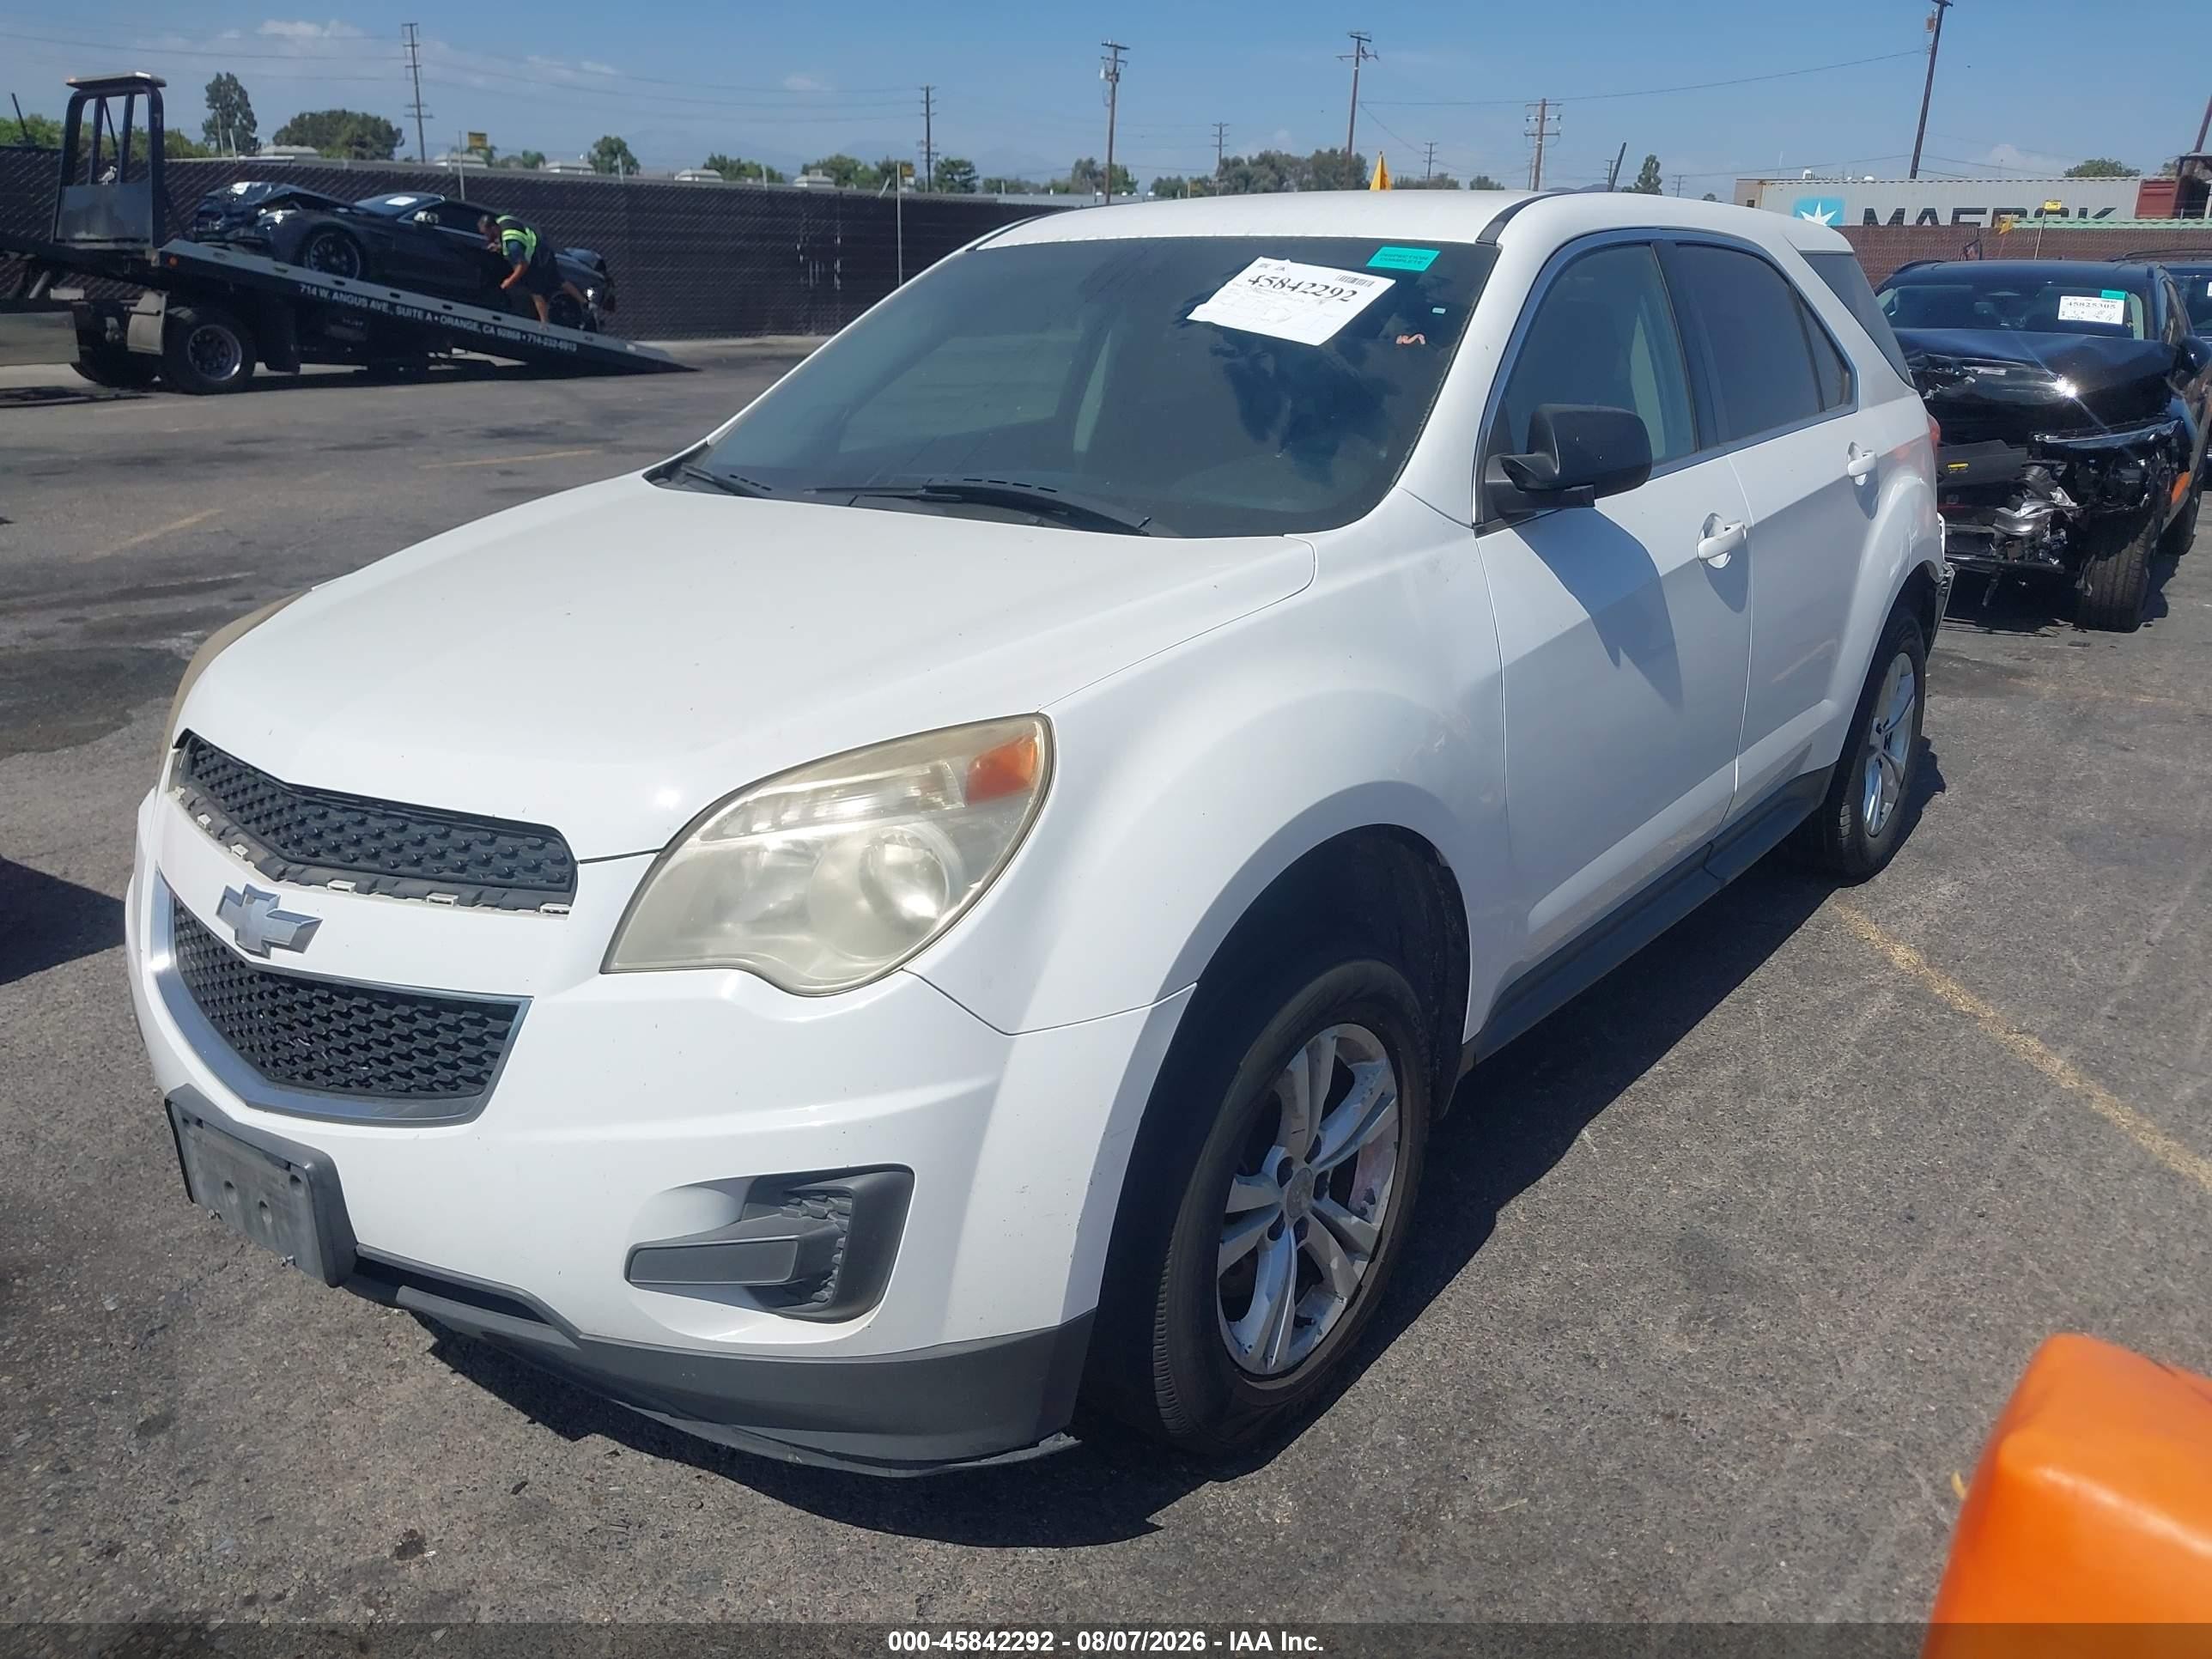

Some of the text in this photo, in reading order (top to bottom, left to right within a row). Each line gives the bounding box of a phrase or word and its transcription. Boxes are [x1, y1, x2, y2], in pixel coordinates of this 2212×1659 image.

[1248, 274, 1358, 302] 45842292
[300, 284, 317, 297] 714
[331, 292, 368, 307] ANGUS
[396, 306, 423, 319] SUITE
[426, 311, 433, 322] A
[483, 325, 495, 335] CA
